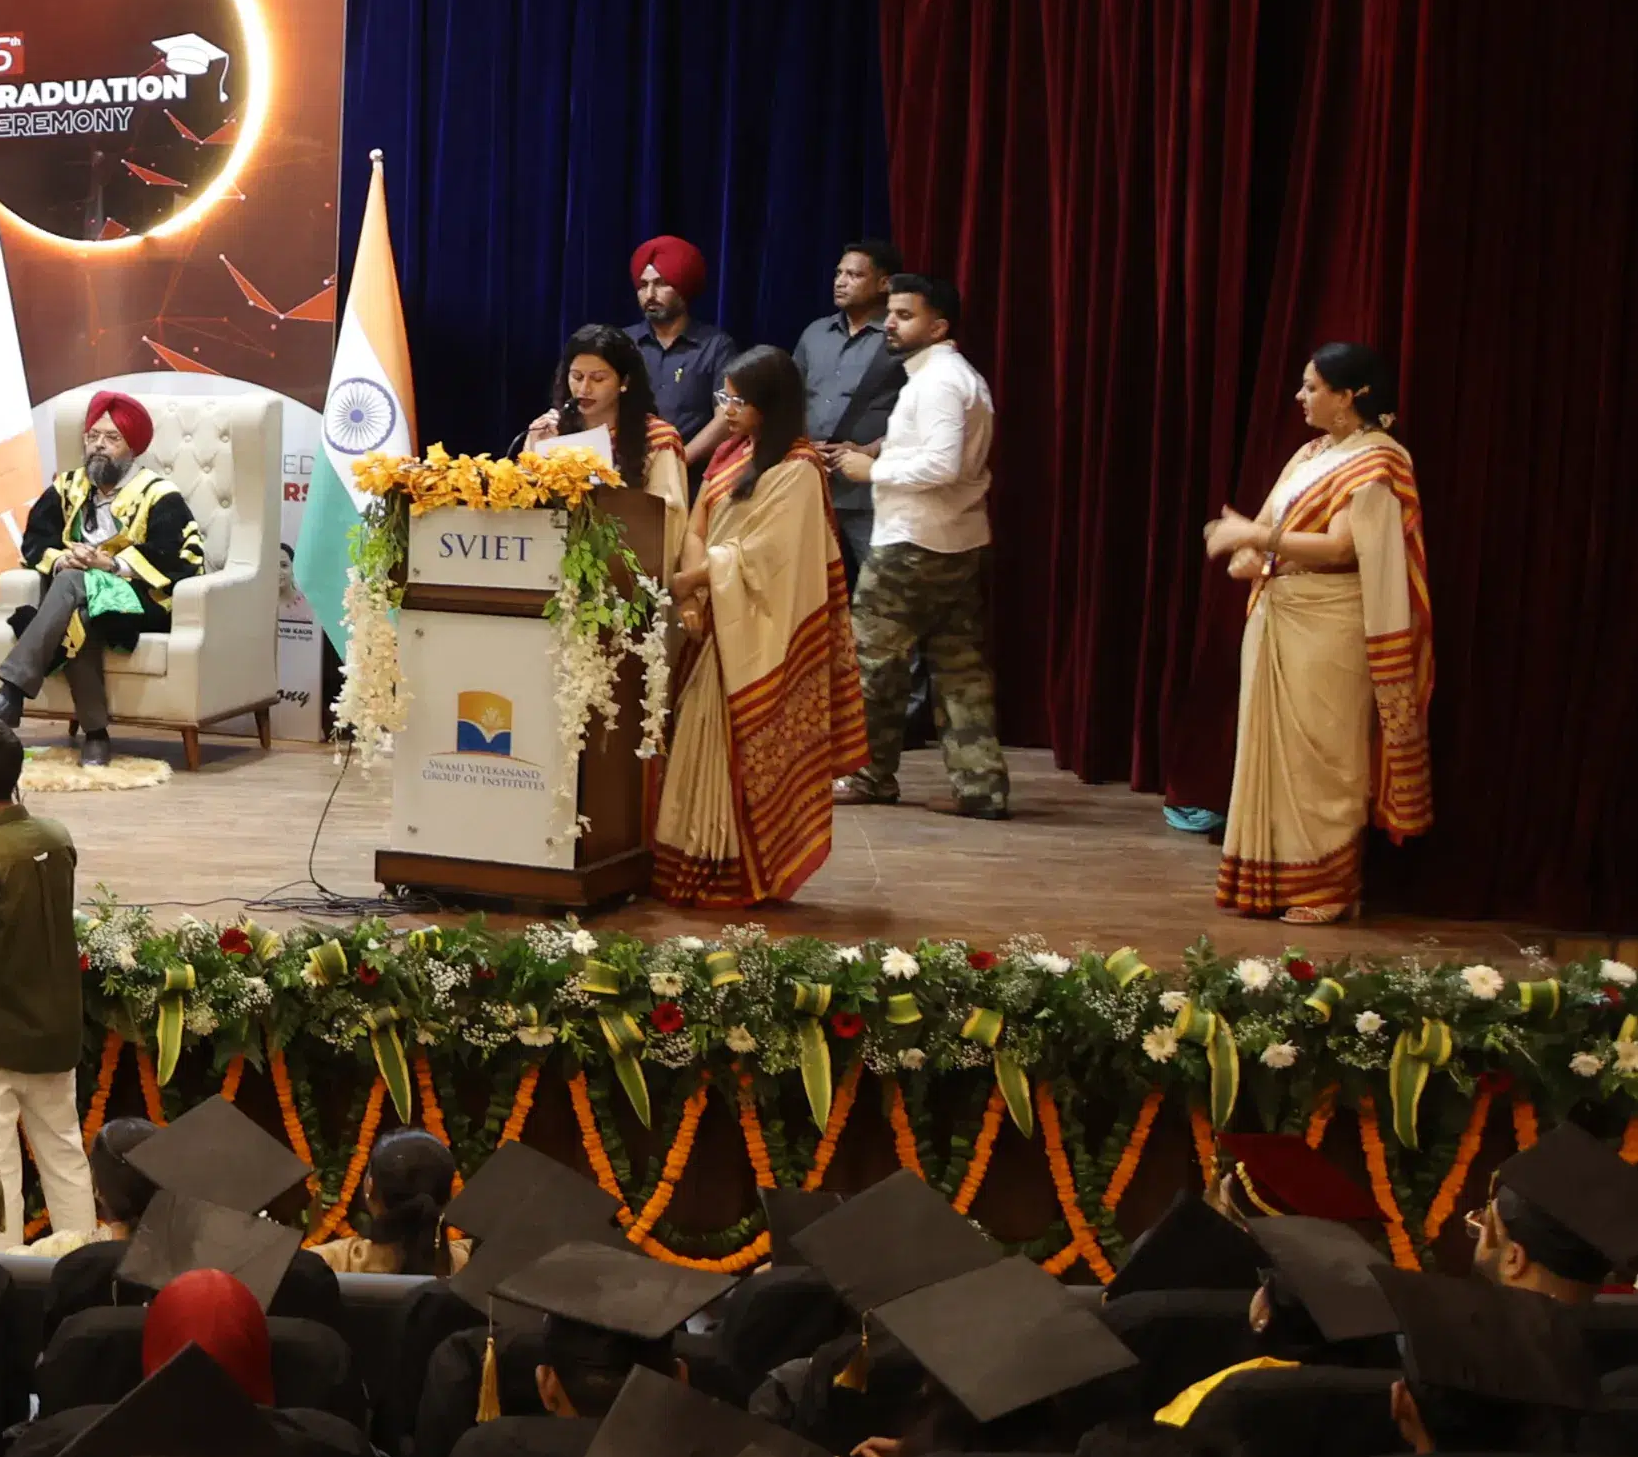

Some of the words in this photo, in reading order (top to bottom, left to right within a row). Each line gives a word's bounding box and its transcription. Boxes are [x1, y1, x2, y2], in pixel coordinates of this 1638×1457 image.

[439, 532, 534, 562] SVIET
[429, 759, 465, 773] SWAMI
[467, 762, 542, 779] VIVEKANAND
[422, 770, 461, 782] GROUP
[464, 774, 477, 784] OF
[482, 775, 545, 792] INSTITUTES
